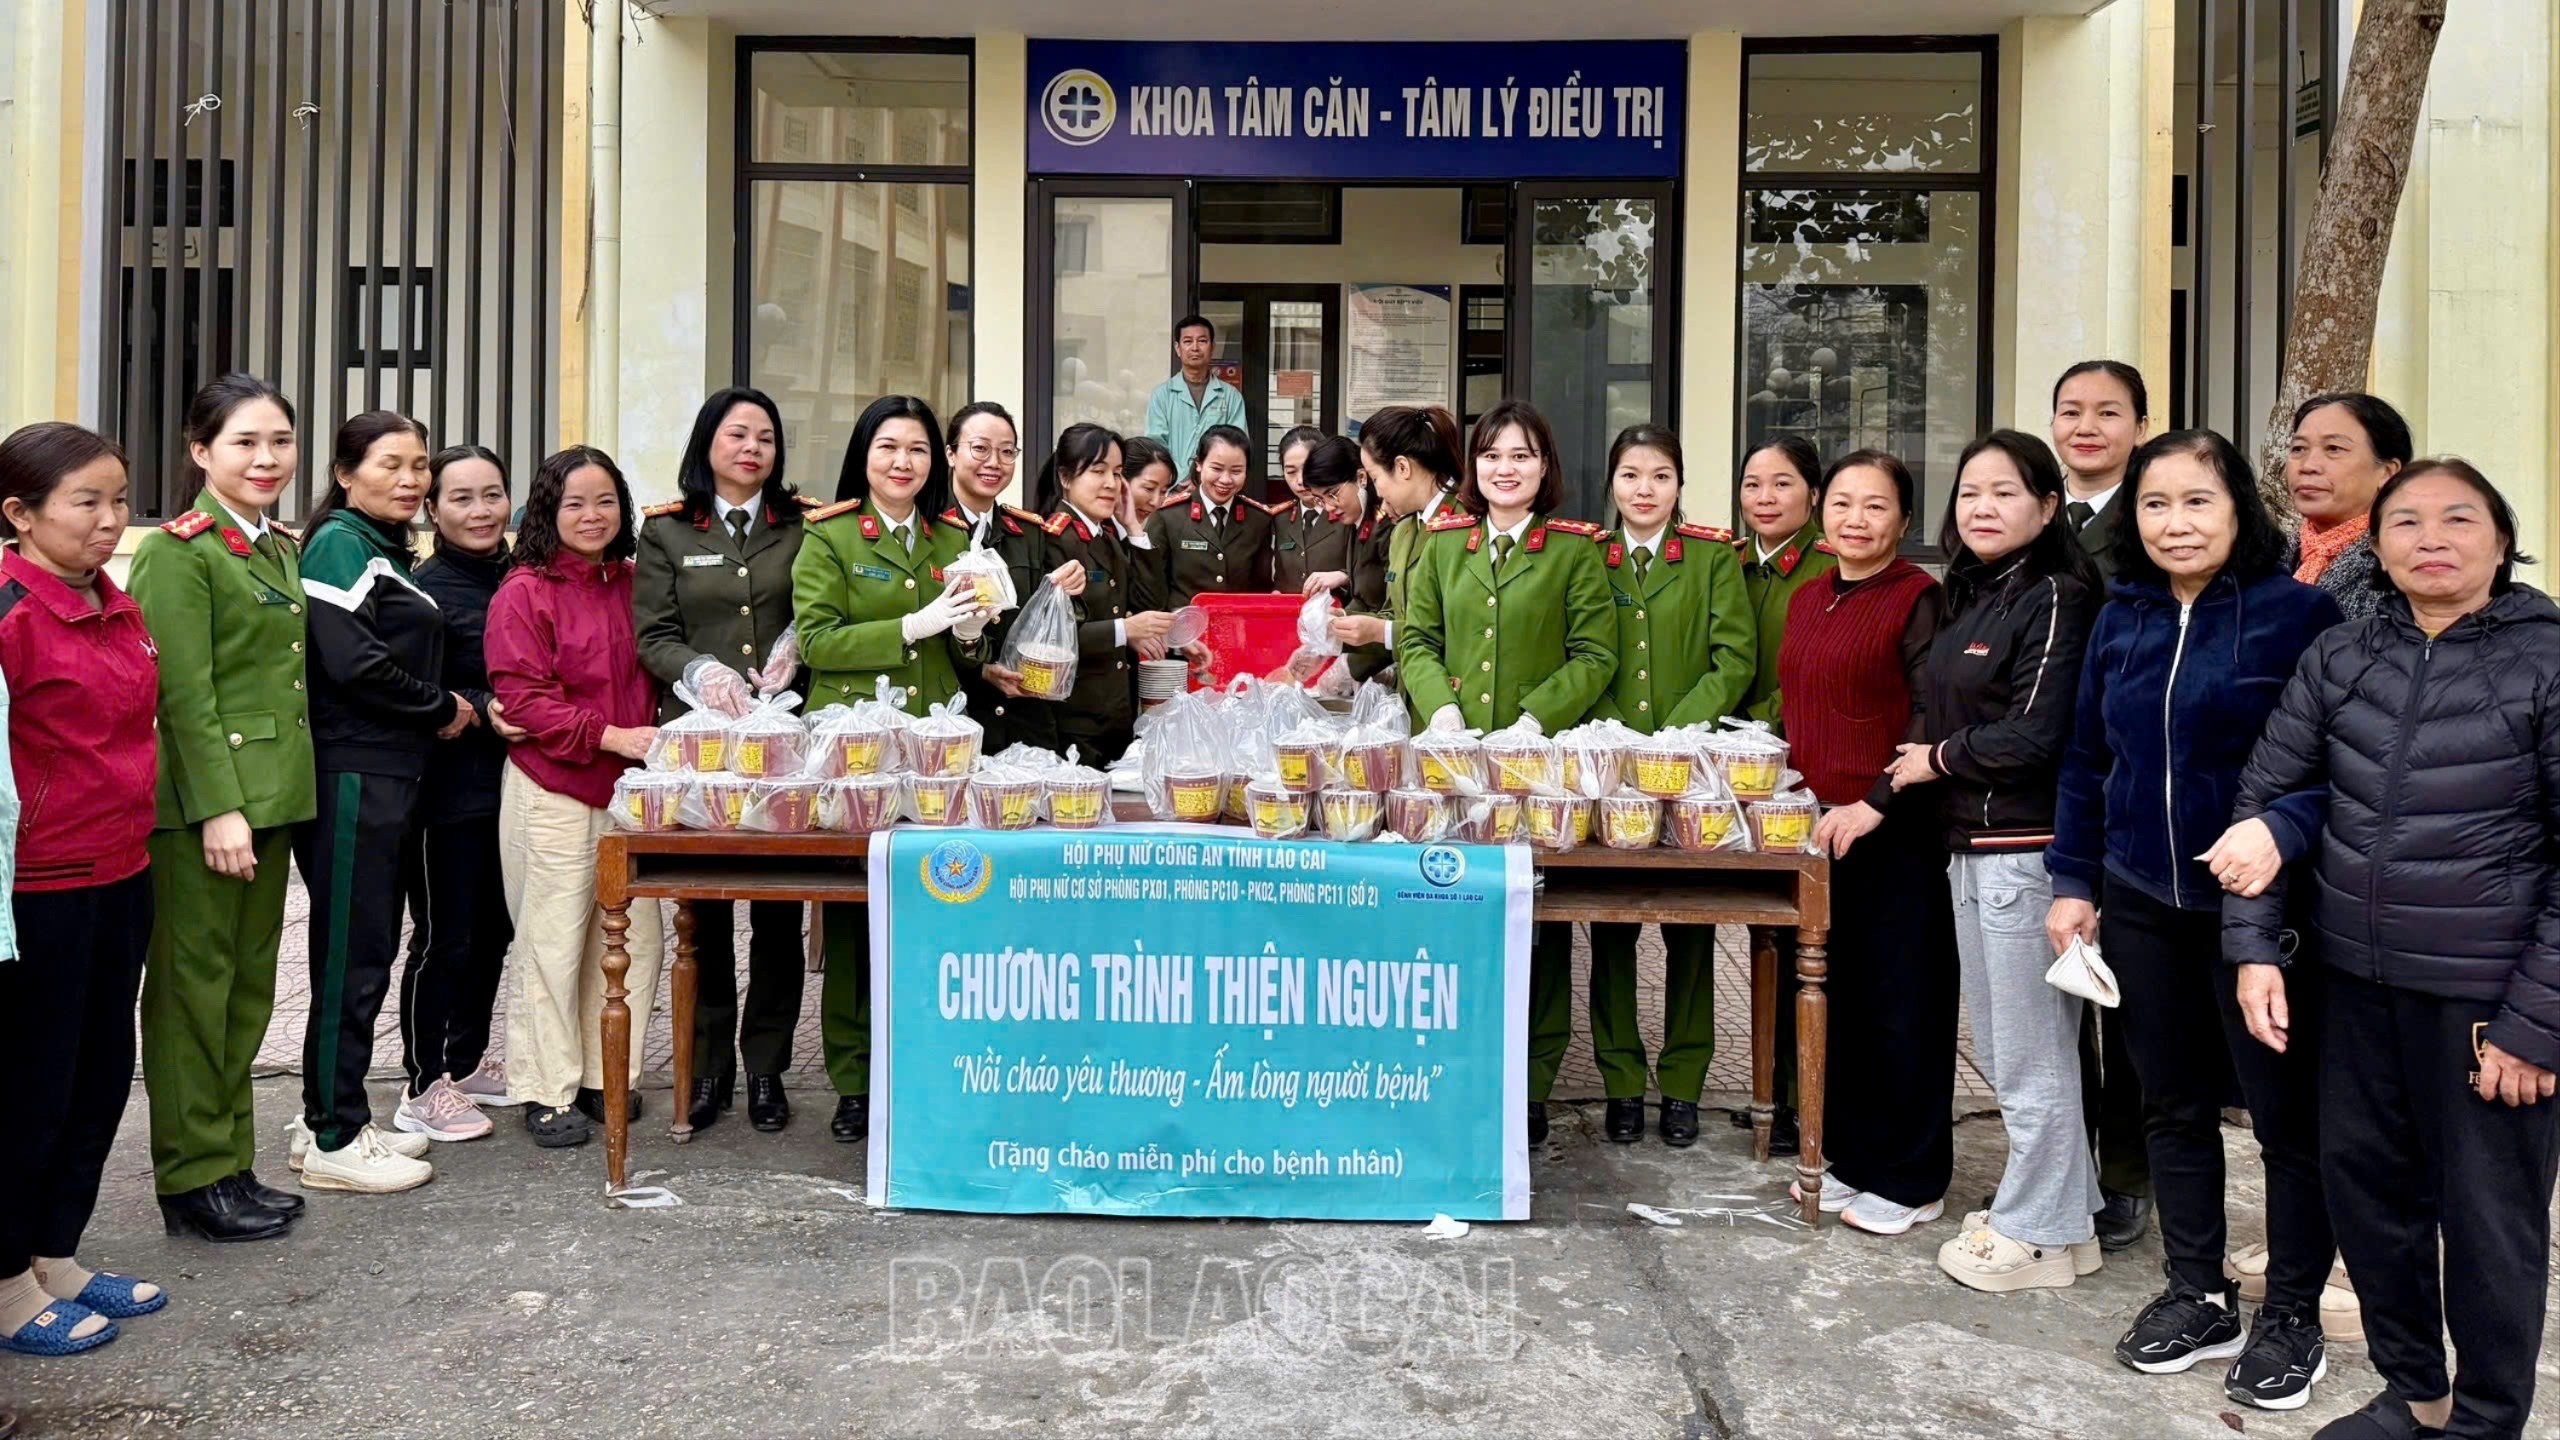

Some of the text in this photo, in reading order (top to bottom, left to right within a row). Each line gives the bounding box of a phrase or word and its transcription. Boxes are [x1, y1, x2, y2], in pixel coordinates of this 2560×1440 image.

[1130, 70, 1664, 149] KHOA TÂM CĂN - TÂM LÝ ĐIỀU TRỊ
[1063, 840, 1089, 869] HỘI
[1094, 844, 1124, 869] PHỤ
[1129, 840, 1154, 866] NỮ
[1155, 840, 1197, 867] CÔNG
[1201, 845, 1223, 867] AN
[1267, 844, 1296, 869] LÀO
[1300, 848, 1327, 870] CAI
[1010, 874, 1027, 903] HỘI
[1030, 877, 1050, 903] PHỤ
[1053, 874, 1070, 899] NỮ
[1071, 876, 1087, 899] CƠ
[1088, 870, 1103, 899] SỞ
[1104, 874, 1139, 899] PHÒNG
[1142, 879, 1172, 902] PX01,
[1174, 874, 1209, 900] PHÒNG
[1211, 879, 1238, 901] PC10
[1248, 881, 1277, 904] PK02,
[1279, 878, 1314, 904] PHÒNG
[1317, 883, 1343, 905] PC11
[1347, 877, 1367, 907] (SỐ
[1368, 885, 1379, 908] 2)
[939, 939, 1458, 1046] CHƯƠNG TRÌNH THIỆN NGUYỆN
[1006, 1054, 1059, 1094] cháo
[1061, 1054, 1104, 1103] yêu
[1109, 1059, 1186, 1108] thương
[1192, 1078, 1201, 1088] -
[1205, 1042, 1245, 1100] Ấm
[1250, 1058, 1300, 1108] lòng
[1305, 1060, 1371, 1108] người
[988, 1140, 1404, 1180] (Tặng cháo miễn phí cho bệnh nhân)
